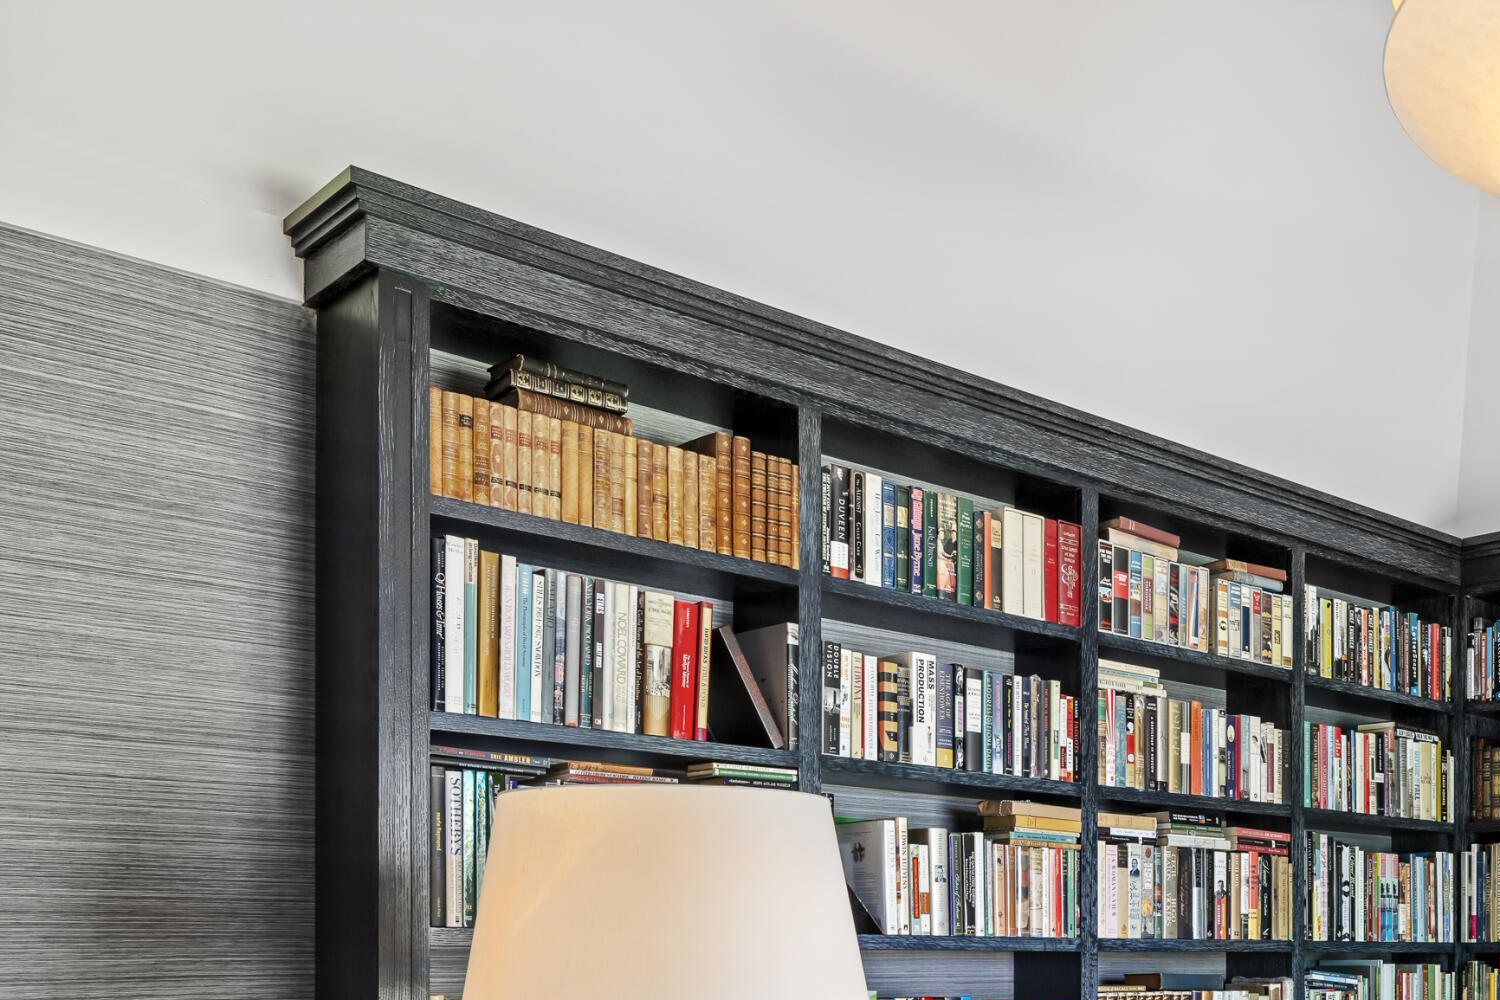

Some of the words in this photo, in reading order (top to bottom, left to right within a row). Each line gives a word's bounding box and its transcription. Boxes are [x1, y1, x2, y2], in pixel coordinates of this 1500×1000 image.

[912, 488, 922, 500] My
[838, 498, 846, 540] DUVEEN
[912, 500, 922, 530] Chicago
[912, 529, 922, 551] Jane
[927, 525, 935, 541] Isak
[911, 551, 922, 577] Byrne
[927, 542, 935, 568] Dinesen
[435, 572, 445, 583] Of
[435, 584, 445, 610] Houses
[546, 580, 554, 628] PALLADIO
[585, 582, 594, 601] NEW
[584, 602, 593, 622] YORK
[617, 612, 627, 638] NOEL
[436, 620, 446, 640] Time
[584, 623, 592, 665] PROCLAIMED
[616, 639, 627, 685] COWARD
[945, 708, 951, 719] OF
